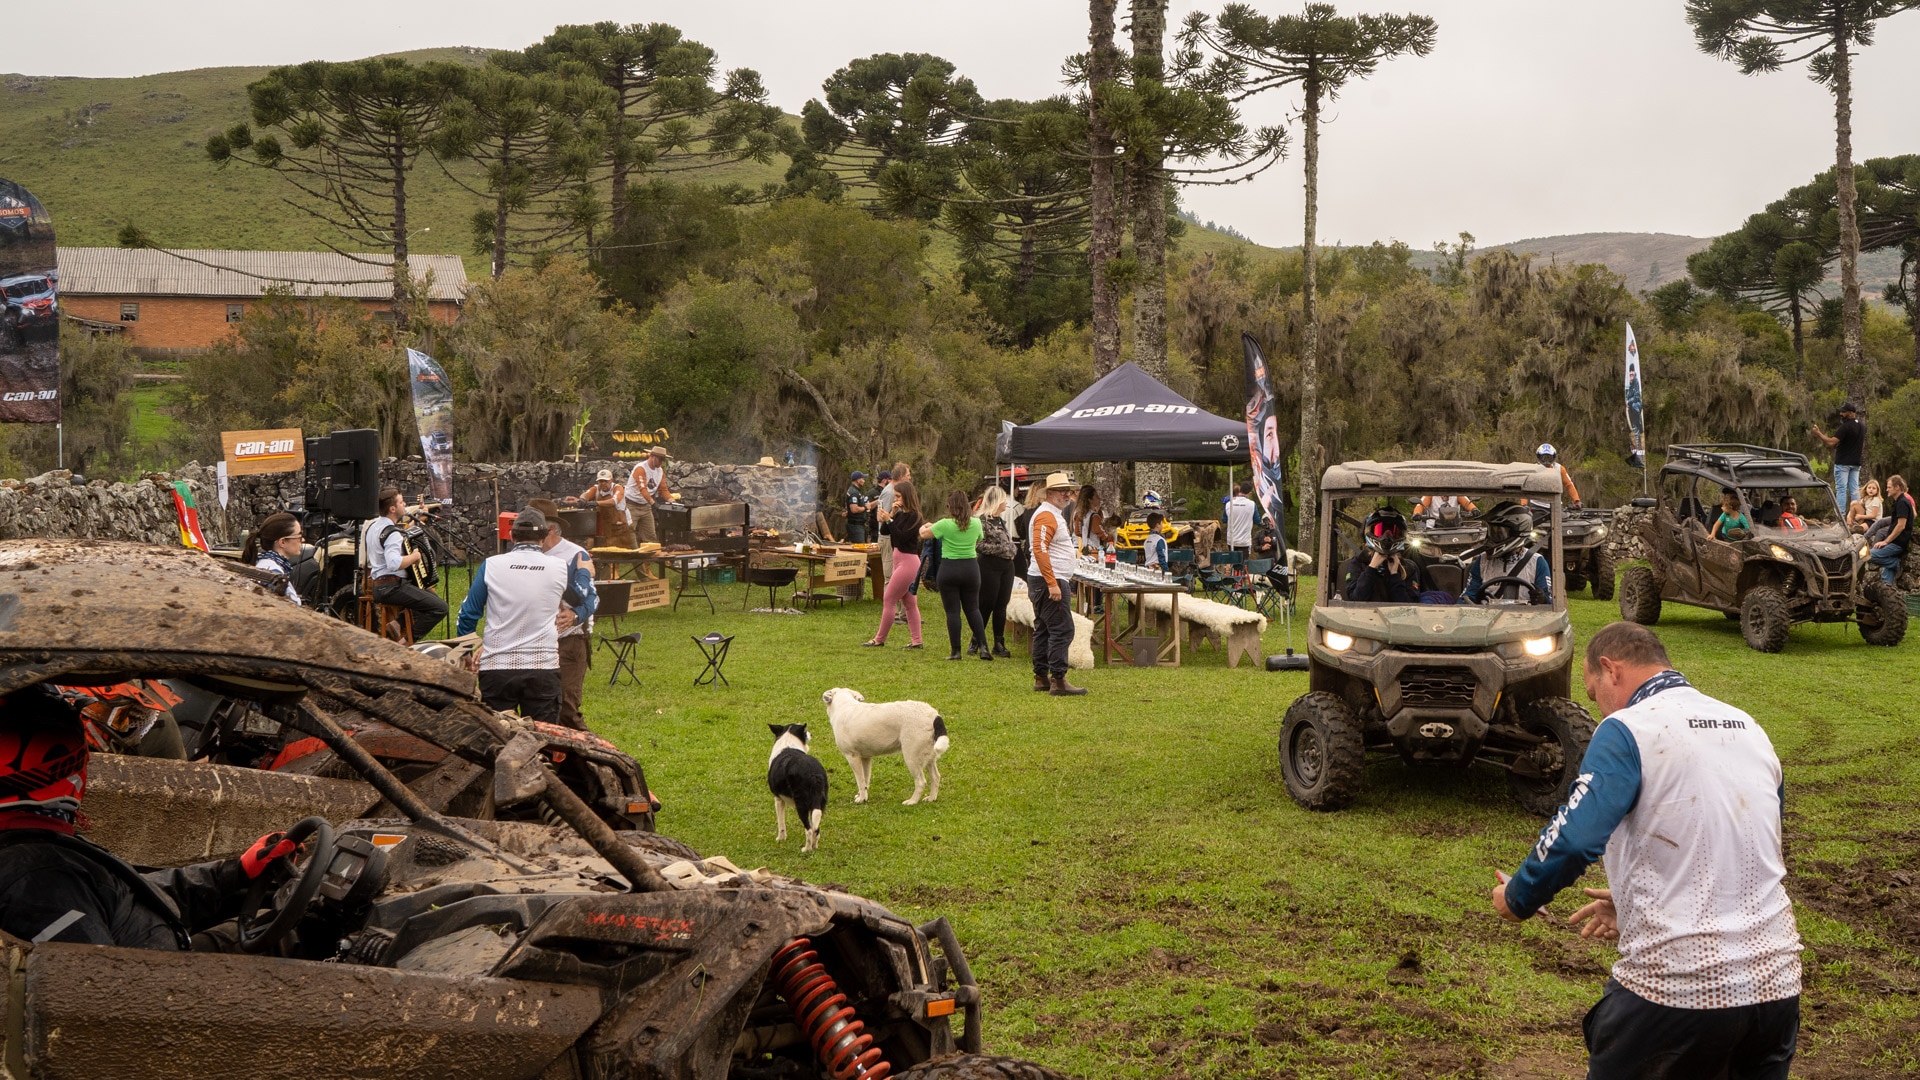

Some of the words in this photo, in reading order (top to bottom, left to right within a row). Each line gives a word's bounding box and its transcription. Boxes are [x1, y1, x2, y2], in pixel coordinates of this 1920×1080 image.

[1071, 403, 1198, 419] can-am
[235, 439, 295, 456] can-am
[1688, 718, 1746, 730] can-am
